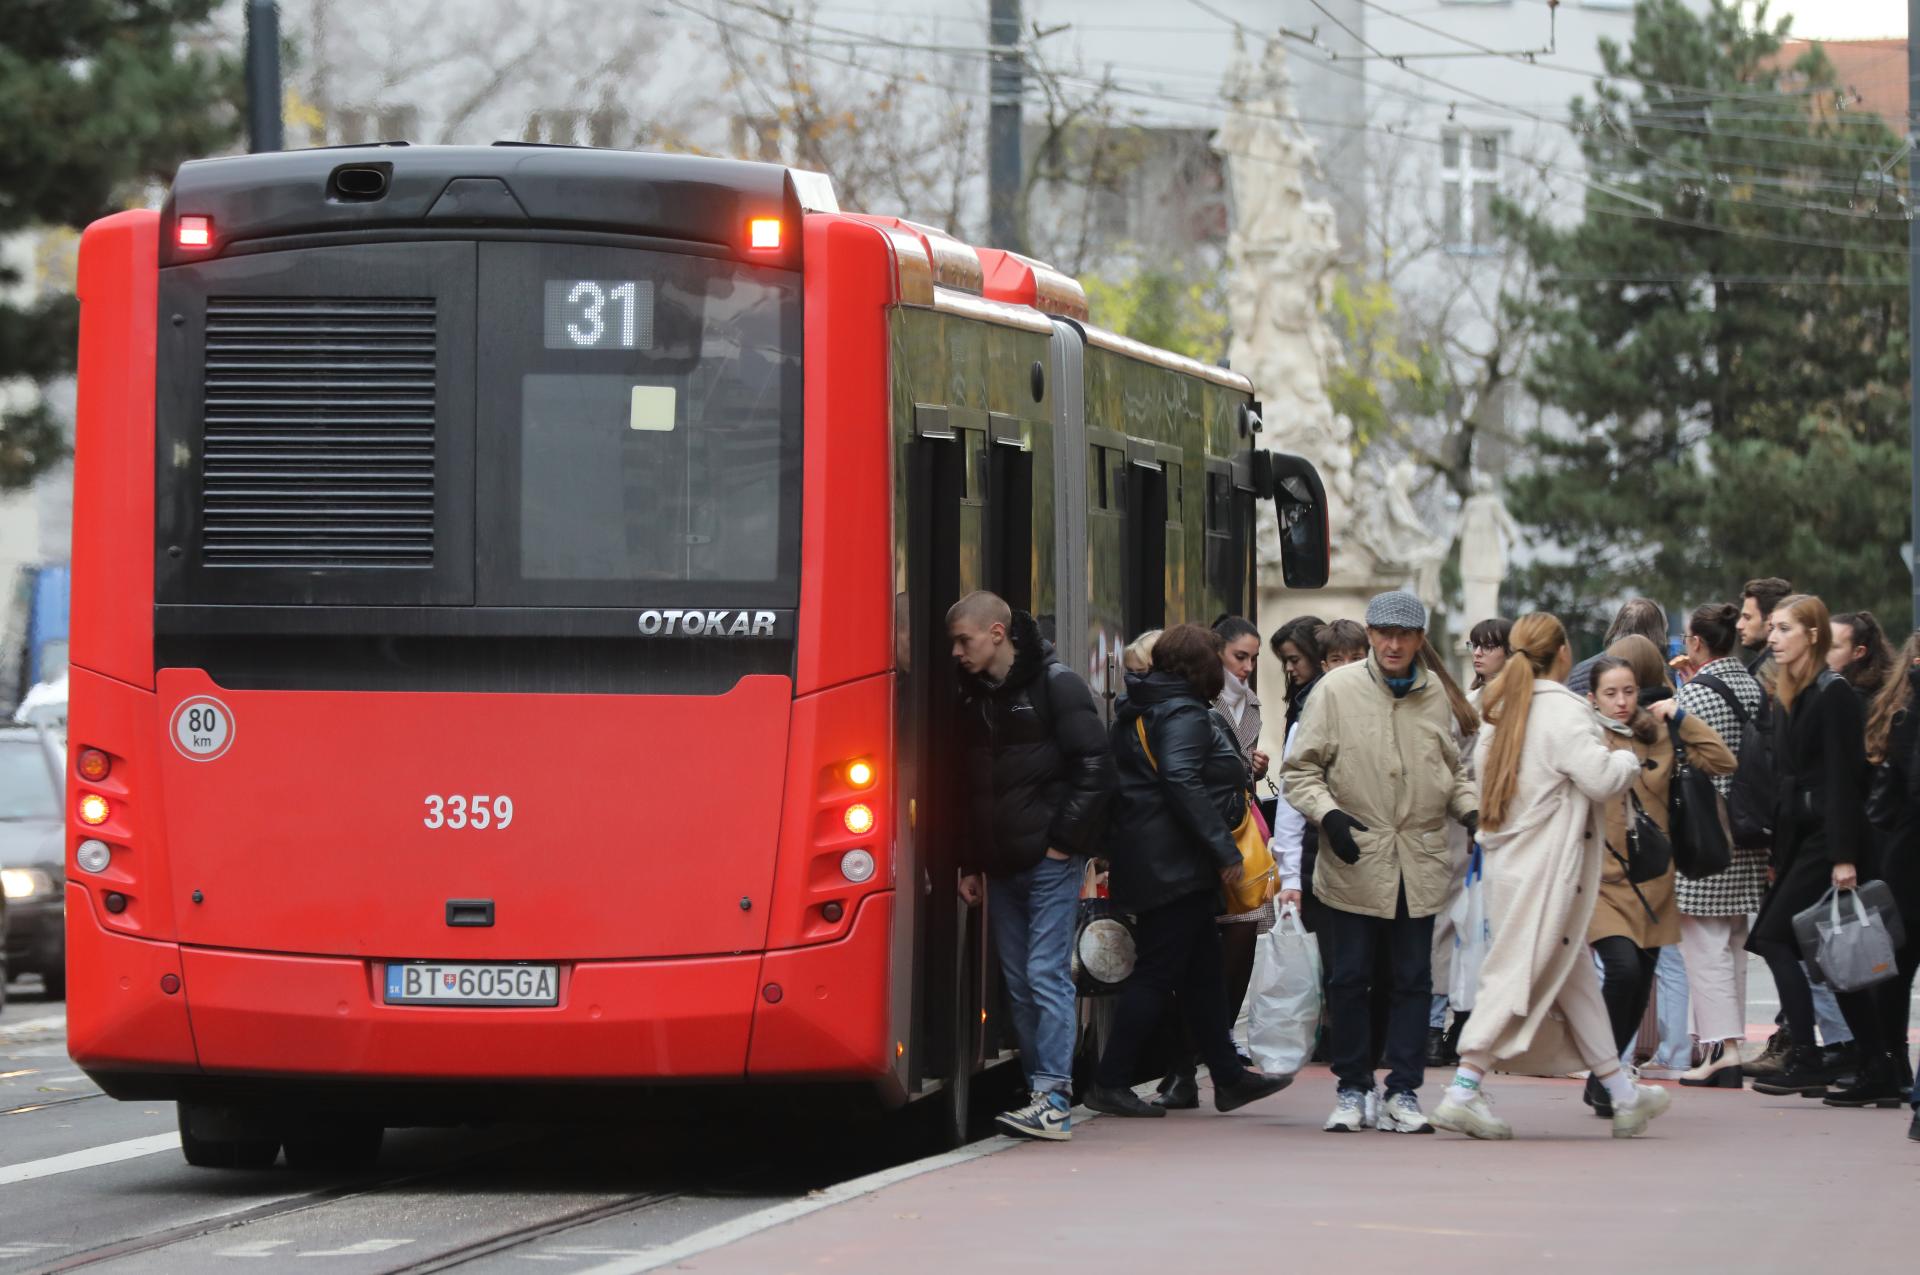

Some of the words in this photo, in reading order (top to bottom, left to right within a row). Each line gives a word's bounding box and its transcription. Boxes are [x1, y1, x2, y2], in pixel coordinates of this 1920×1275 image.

[568, 281, 635, 346] 31
[638, 610, 776, 636] OTOKAR
[189, 708, 215, 732] 80
[193, 735, 211, 747] km
[423, 794, 513, 830] 3359
